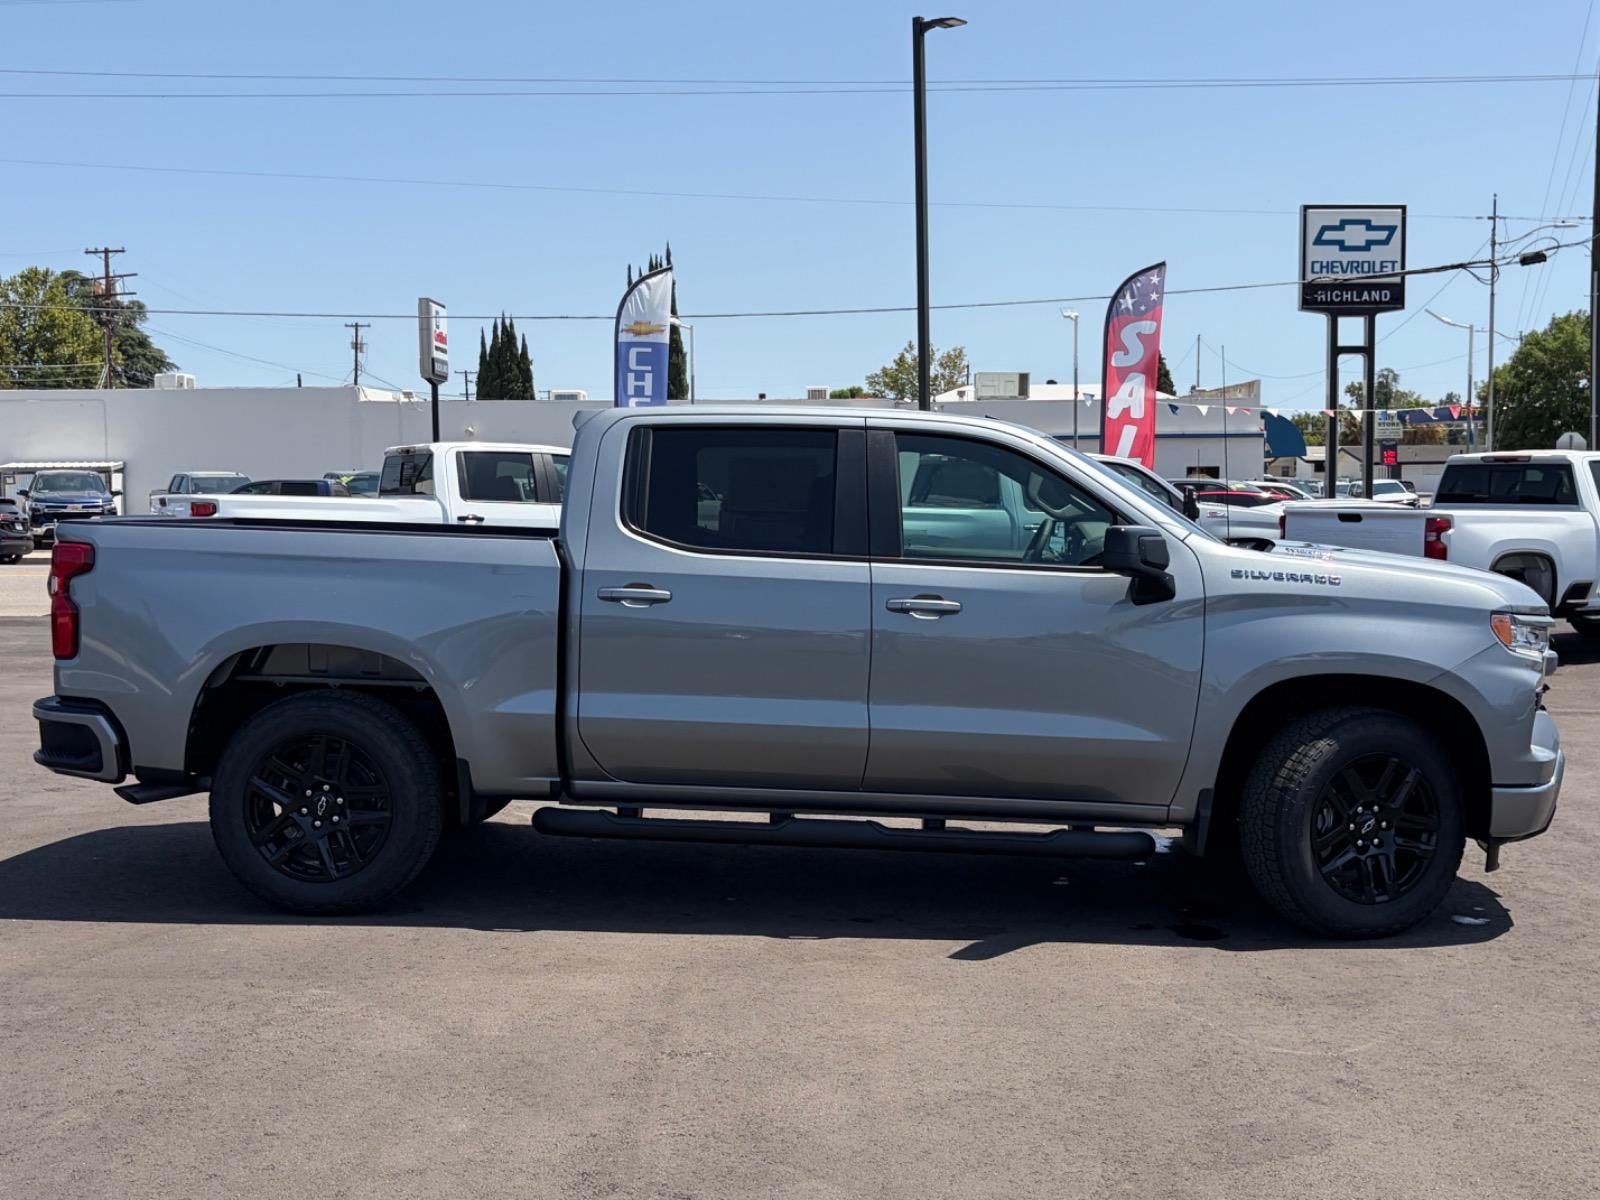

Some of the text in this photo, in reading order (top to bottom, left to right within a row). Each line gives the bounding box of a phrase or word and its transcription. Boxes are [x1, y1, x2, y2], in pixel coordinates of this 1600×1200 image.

[1311, 261, 1398, 274] CHEVROLET
[1316, 290, 1391, 302] RICHLAND
[1230, 569, 1341, 586] SILVERADO
